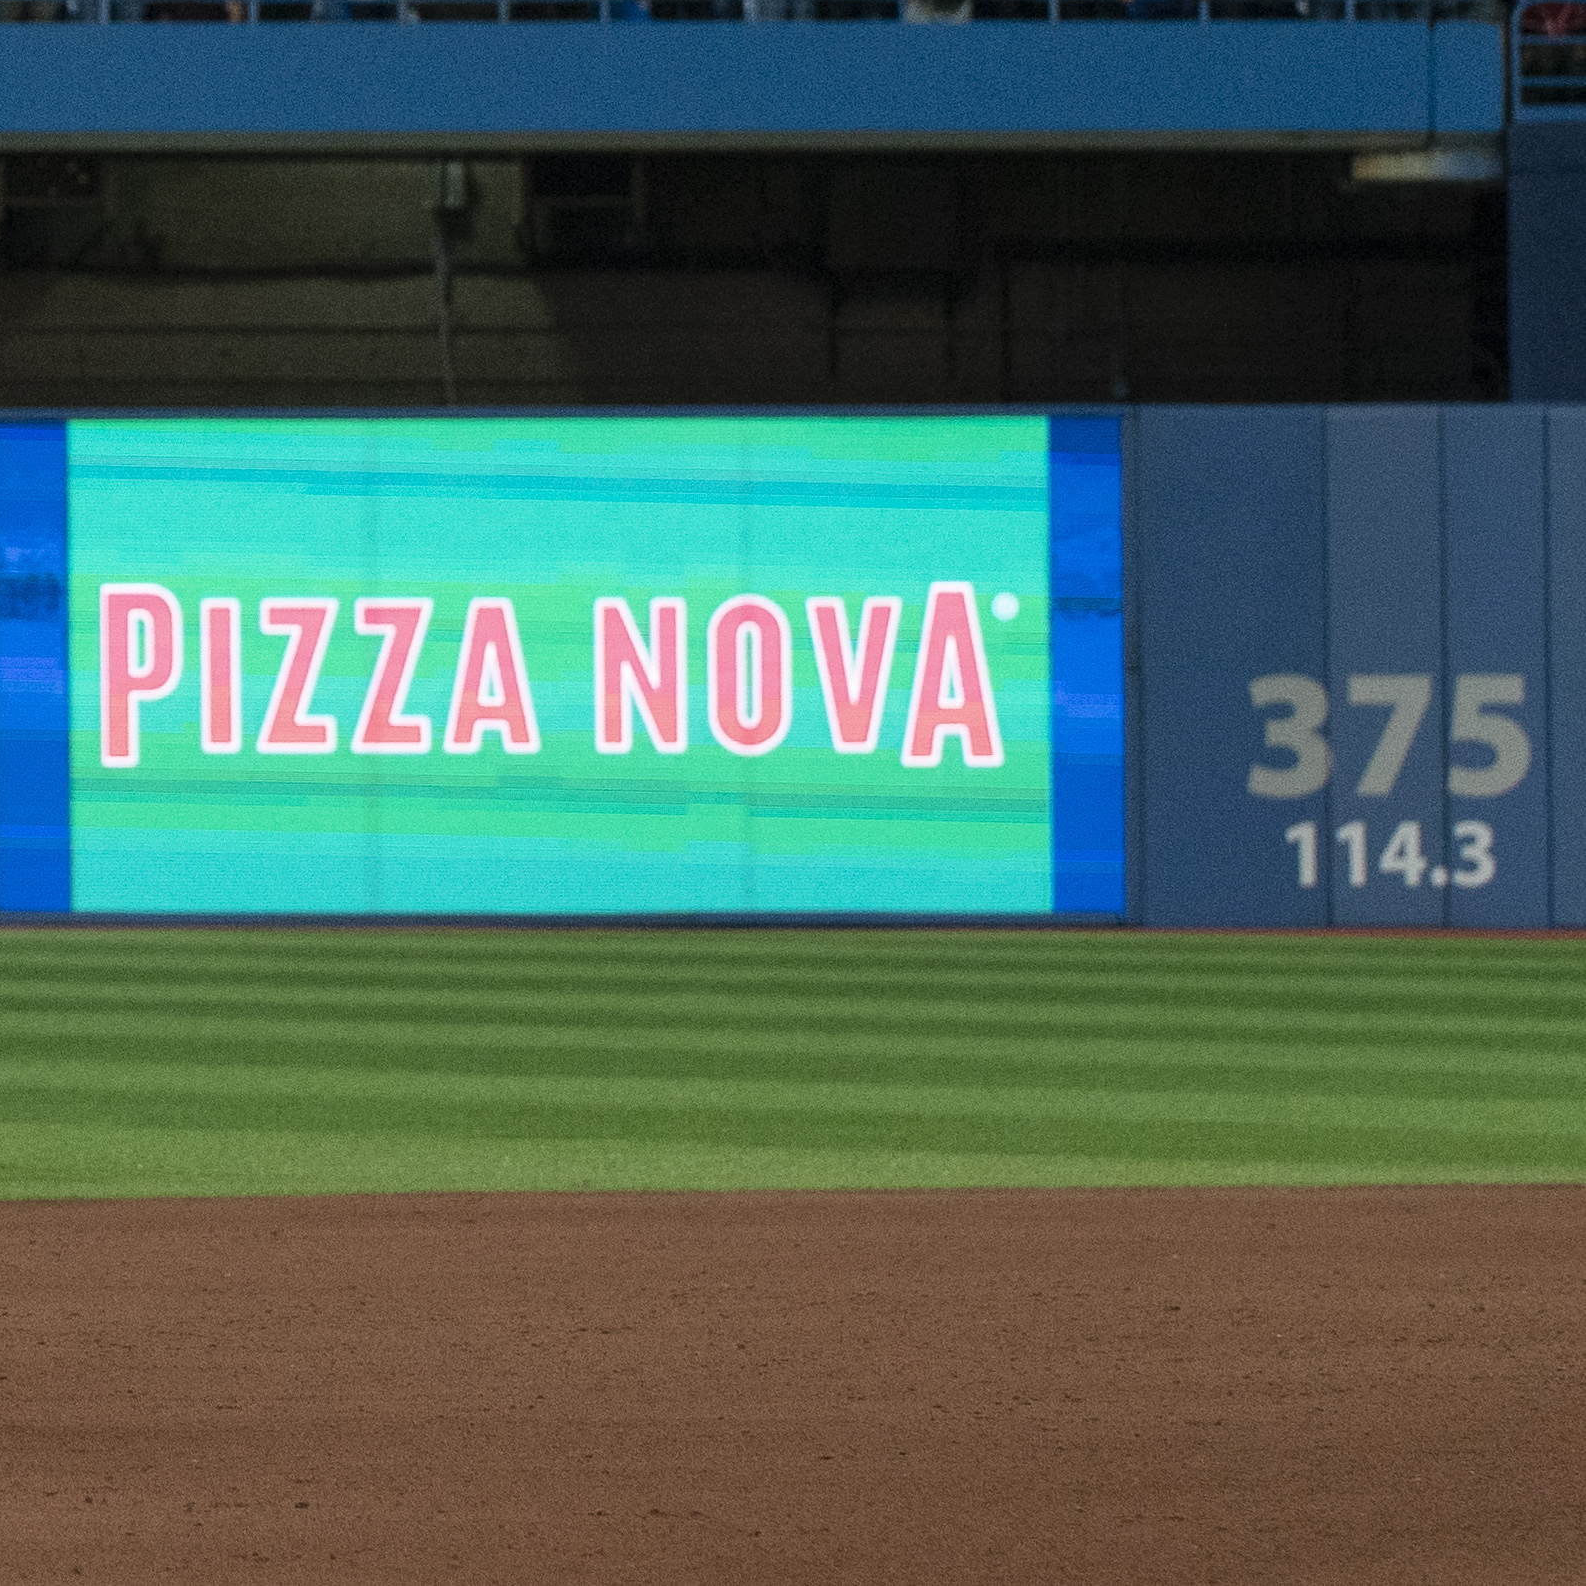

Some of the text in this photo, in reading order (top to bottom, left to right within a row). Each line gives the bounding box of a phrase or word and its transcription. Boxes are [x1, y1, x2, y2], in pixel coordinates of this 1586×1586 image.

[98, 582, 542, 768] PIZZA
[1246, 672, 1532, 800] 375
[1284, 819, 1498, 890] 114.3
